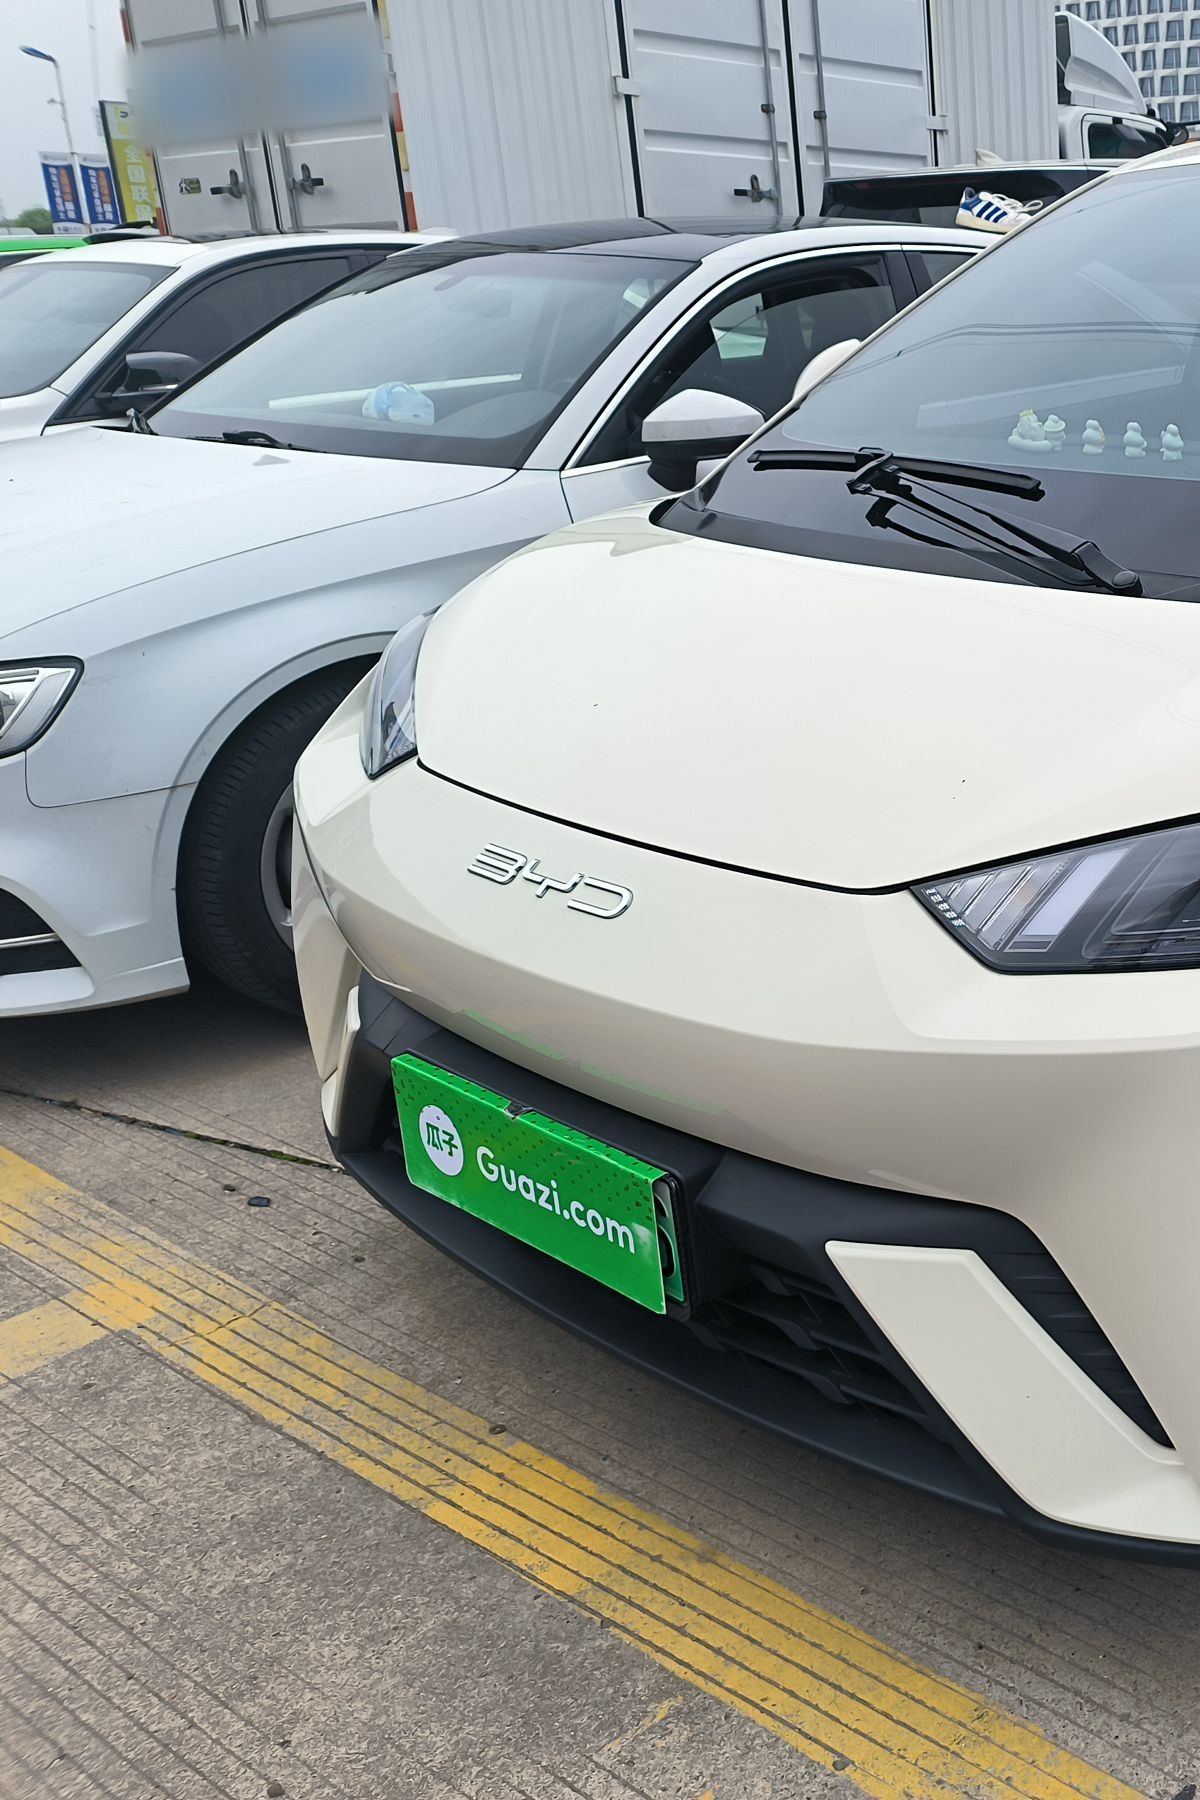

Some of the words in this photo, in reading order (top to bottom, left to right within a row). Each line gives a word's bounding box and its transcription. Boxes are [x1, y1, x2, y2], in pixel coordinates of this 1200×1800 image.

[467, 842, 634, 920] BYD
[425, 1122, 459, 1157] 瓜子
[476, 1146, 636, 1254] Guazi.com
